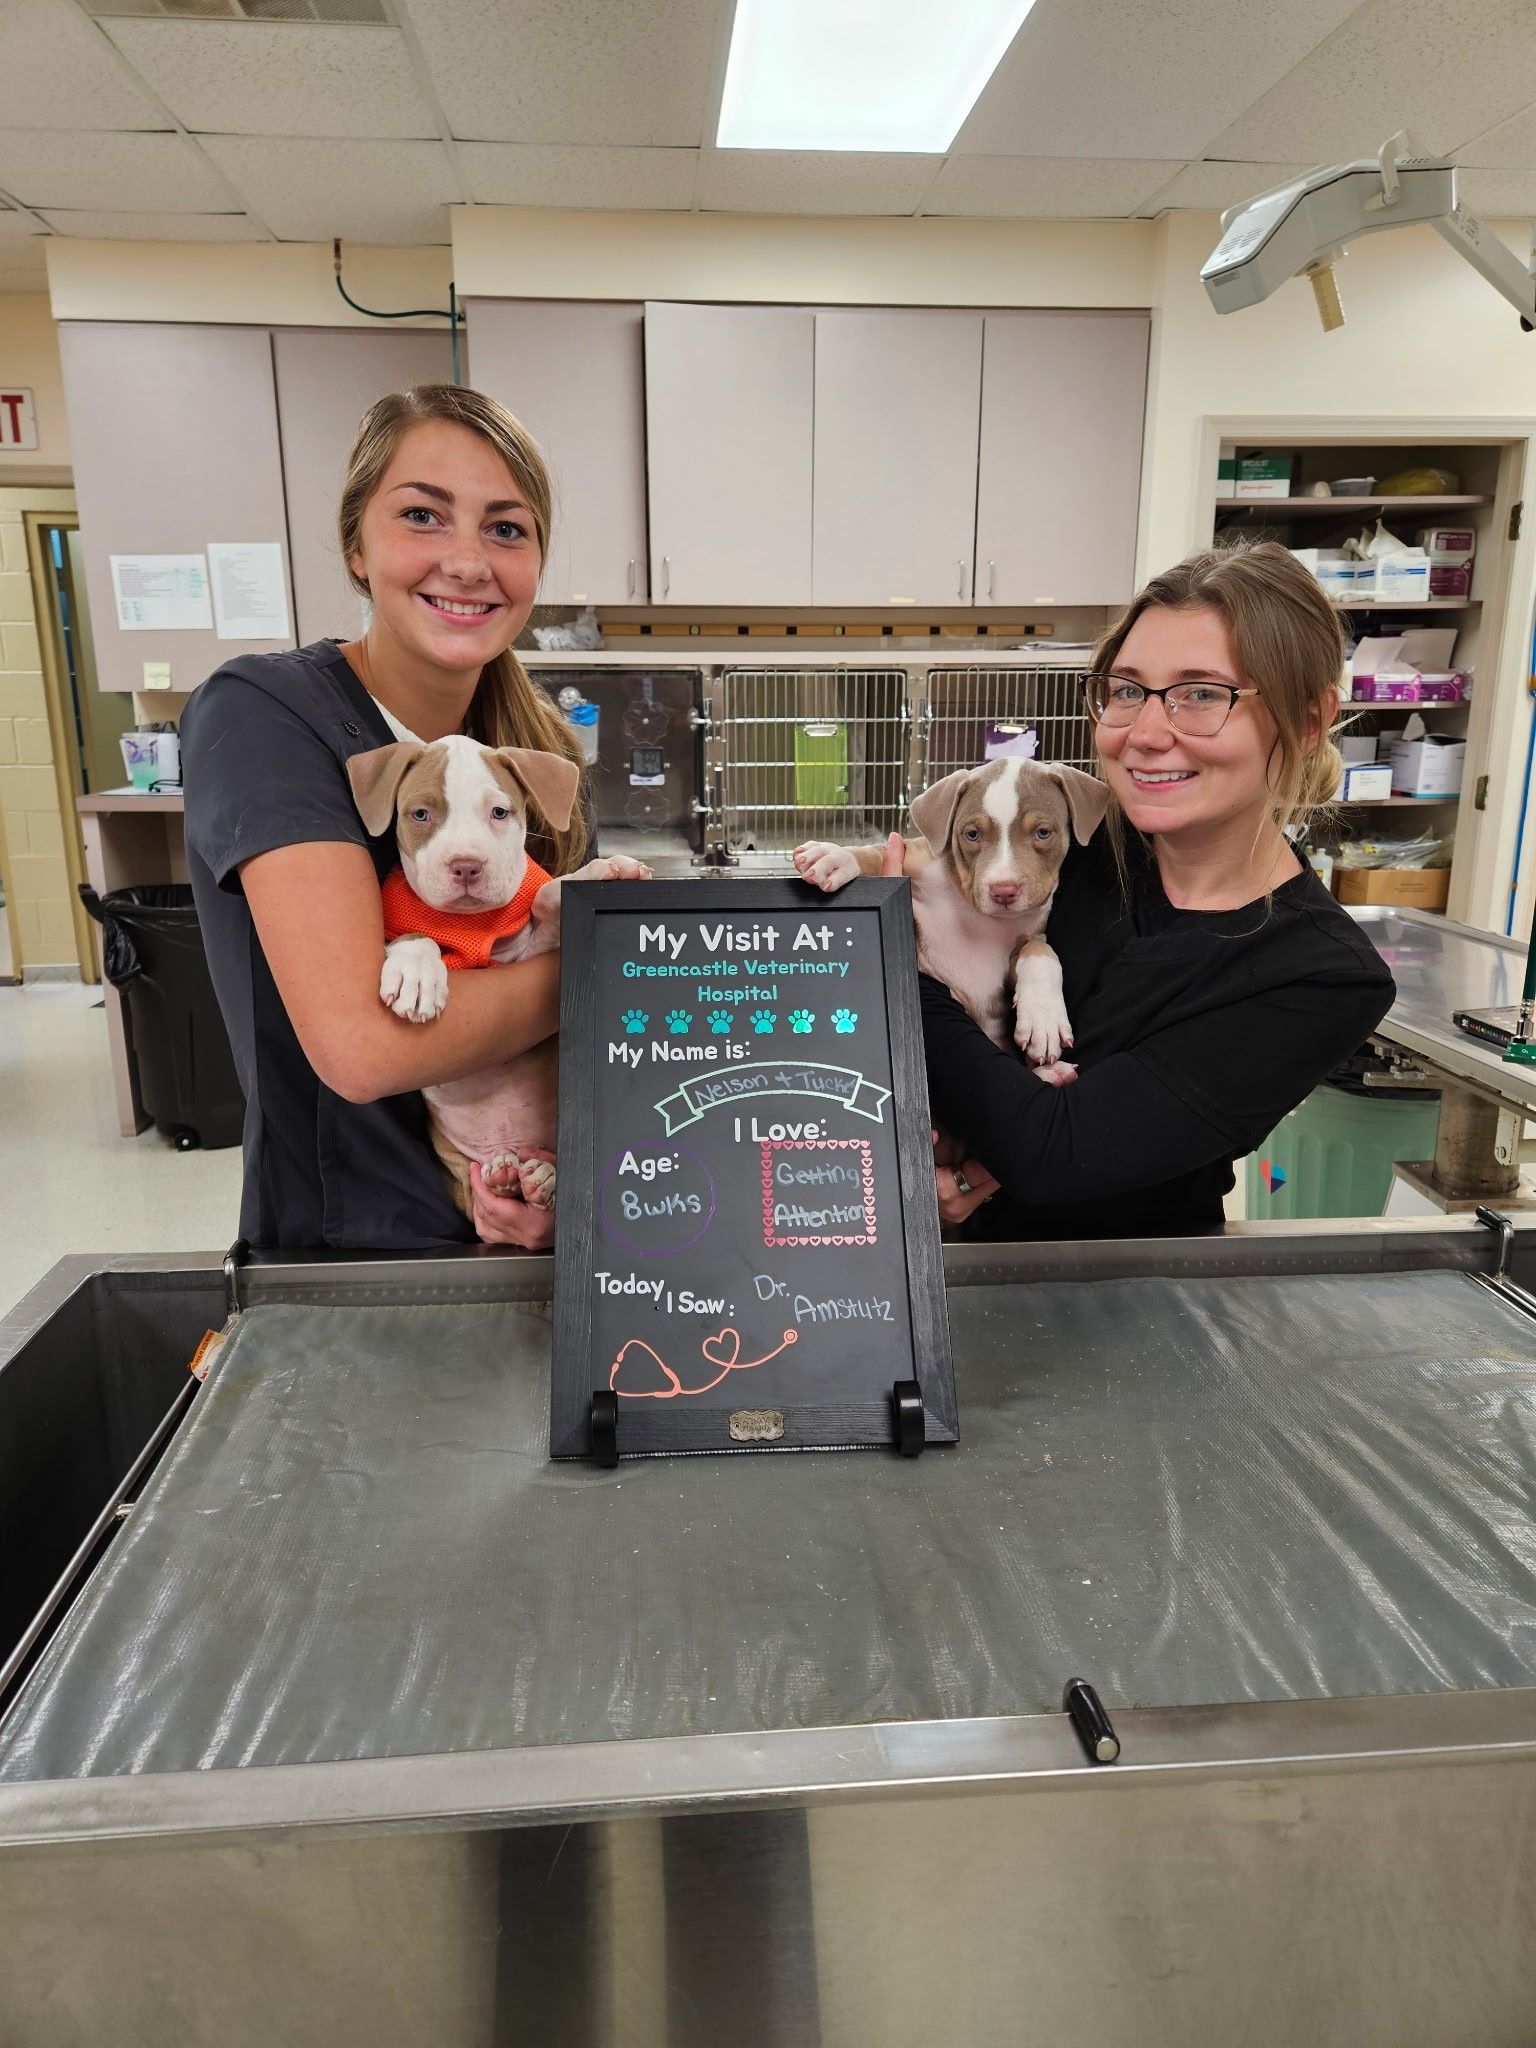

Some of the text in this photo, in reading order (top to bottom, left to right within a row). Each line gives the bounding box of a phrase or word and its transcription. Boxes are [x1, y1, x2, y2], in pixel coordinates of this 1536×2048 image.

[640, 924, 688, 959] My
[699, 924, 780, 951] Visit
[622, 958, 850, 977] Greencastle Veterinary
[698, 985, 778, 1006] Hospital
[608, 1039, 751, 1068] My Name is:
[695, 1074, 768, 1107] Nelson
[734, 1117, 827, 1142] I Love:
[618, 1151, 680, 1181] Age:
[776, 1163, 860, 1189] Getting
[774, 1203, 866, 1228] Attention
[594, 1272, 735, 1316] Today I Saw:
[753, 1274, 790, 1301] Dr.
[794, 1294, 895, 1323] Amstutz
